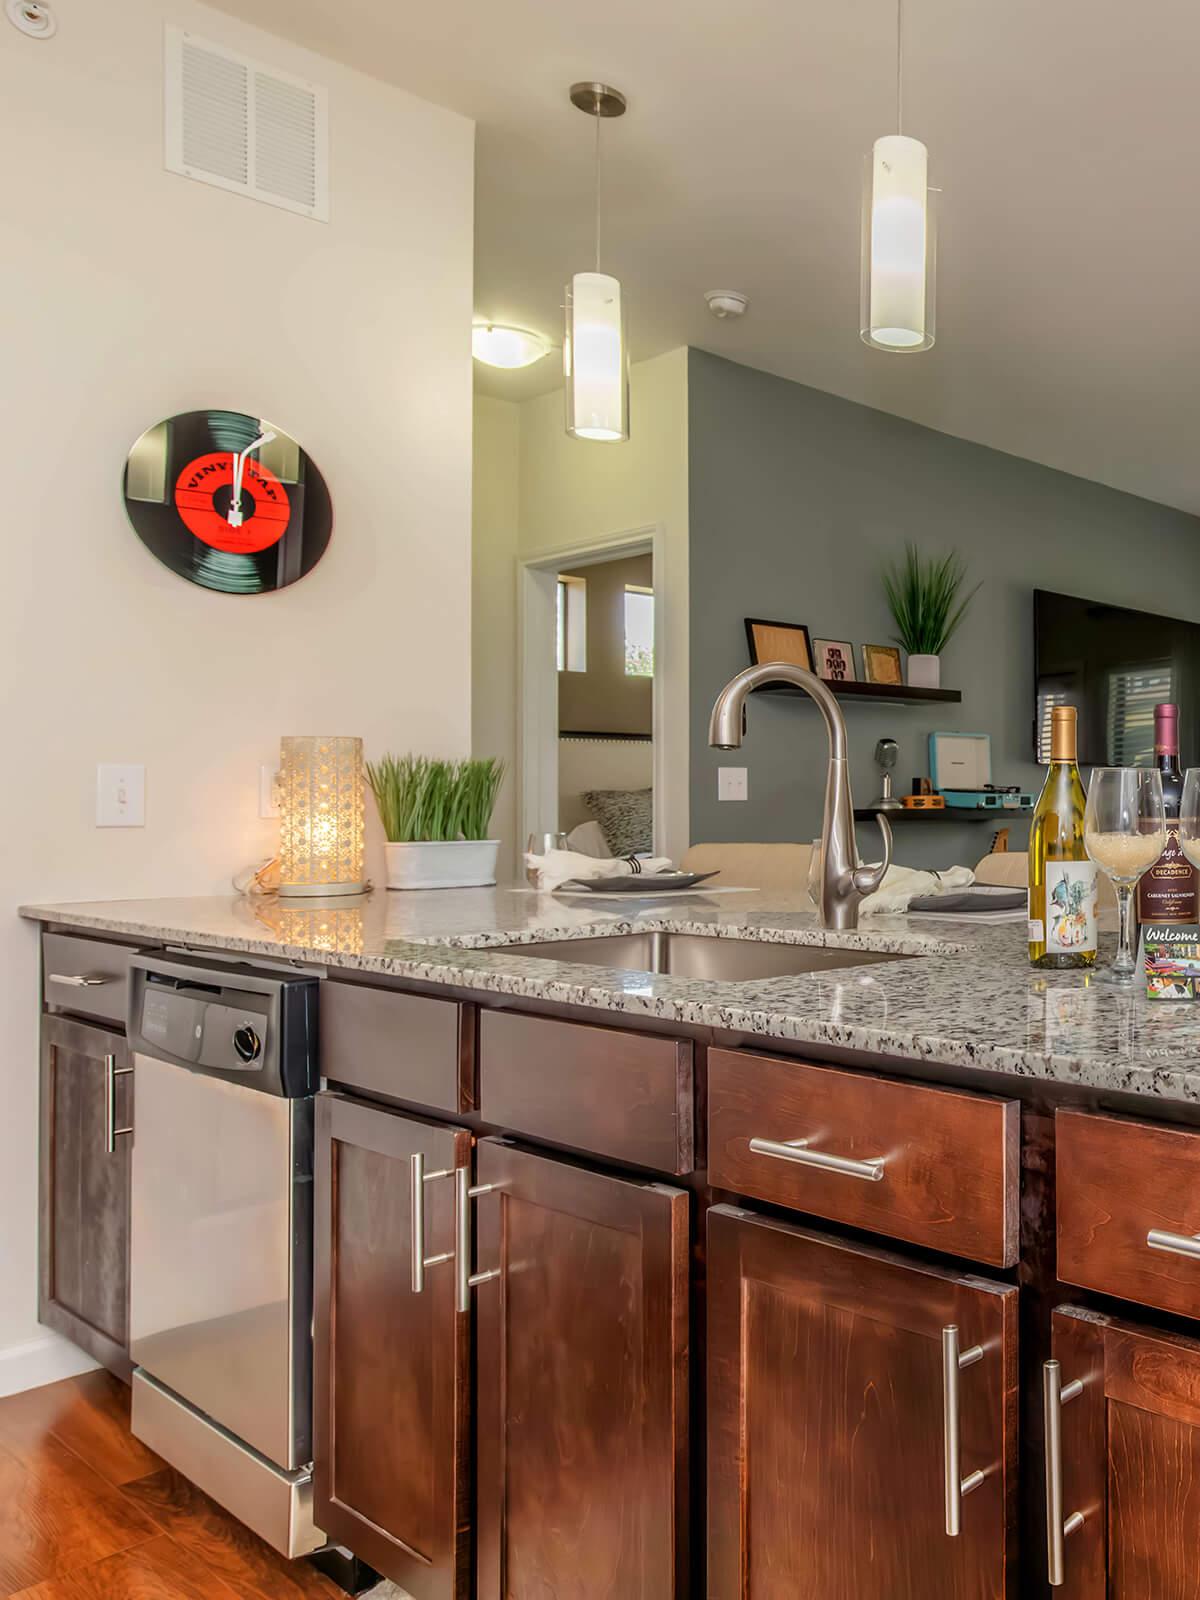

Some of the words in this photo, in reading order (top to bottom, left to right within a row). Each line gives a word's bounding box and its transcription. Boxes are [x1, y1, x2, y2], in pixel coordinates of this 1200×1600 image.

[248, 469, 277, 501] TAP
[1161, 849, 1176, 860] age
[1146, 927, 1199, 941] Welcome
